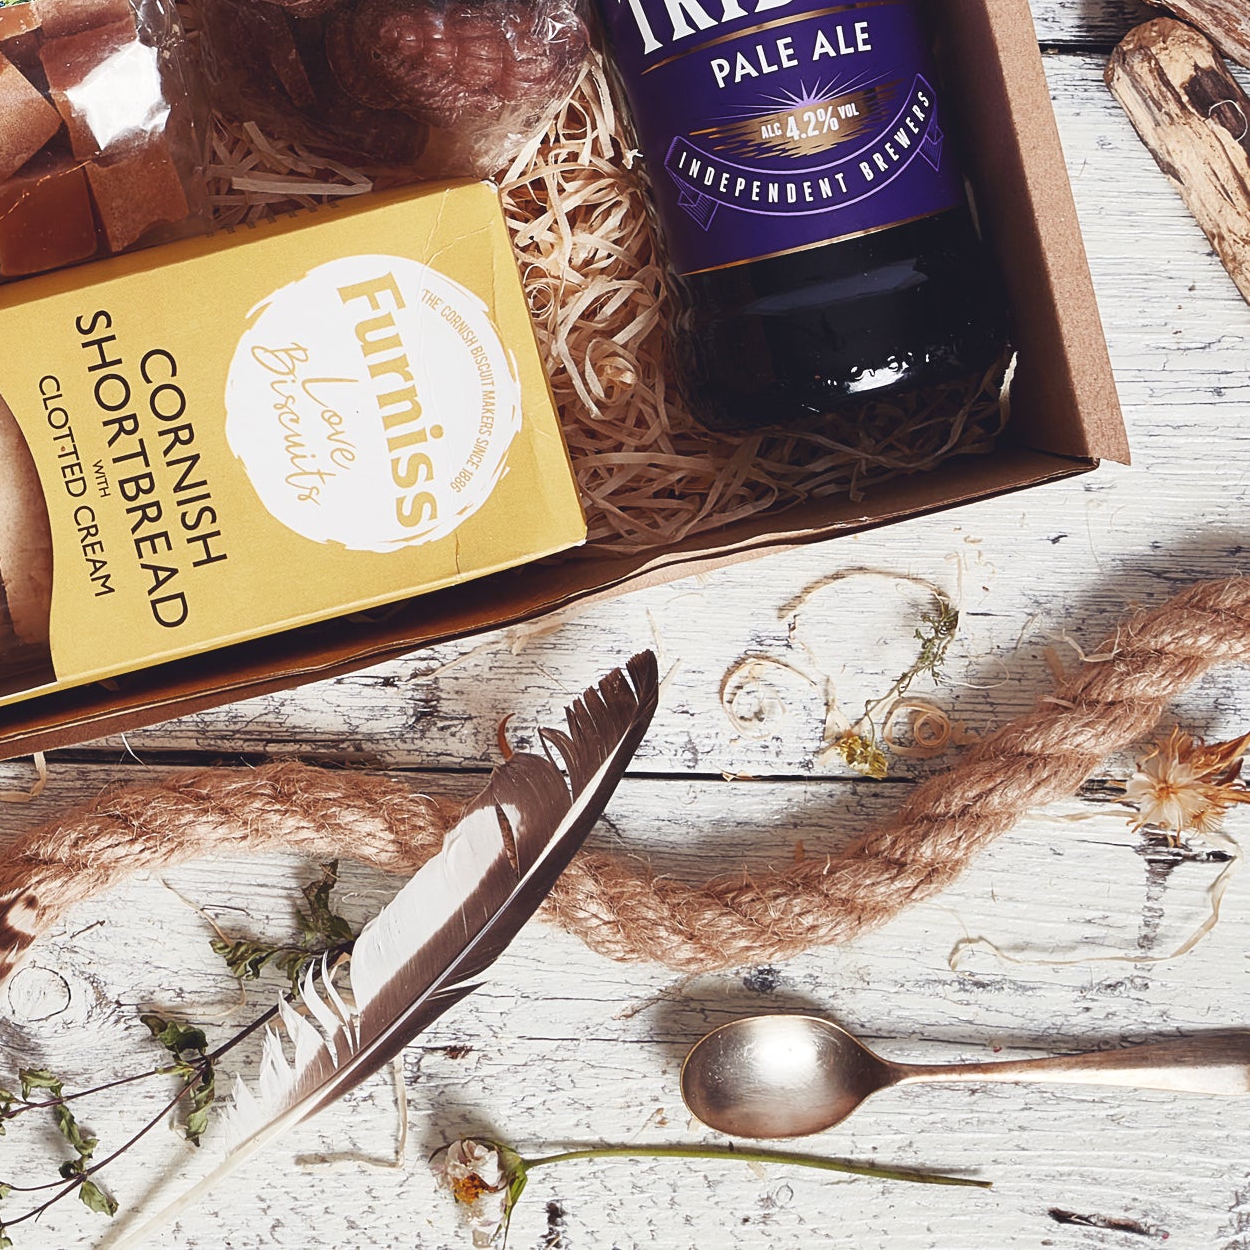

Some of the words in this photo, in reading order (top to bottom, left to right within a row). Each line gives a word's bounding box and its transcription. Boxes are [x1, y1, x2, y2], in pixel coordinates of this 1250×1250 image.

[710, 37, 799, 89] PALE
[812, 21, 872, 62] ALE
[678, 152, 848, 203] INDEPENDENT
[859, 91, 930, 181] BREWERS
[761, 123, 782, 139] ALC
[786, 105, 839, 141] 4.2%
[837, 102, 860, 120] VOL
[421, 289, 442, 310] THE
[440, 305, 478, 348] CORNISH
[470, 345, 495, 387] BISCUIT
[251, 341, 337, 507] Biscuits
[301, 376, 358, 471] Love
[336, 271, 445, 528] Furniss
[478, 389, 496, 437] MAKERS
[75, 310, 189, 629] SHORTBREAD
[92, 459, 111, 498] WITH
[140, 348, 228, 568] CORNISH
[450, 468, 474, 493] 1886
[466, 436, 489, 470] SINCE
[38, 375, 87, 498] CLOTTED
[72, 505, 115, 598] CREAM
